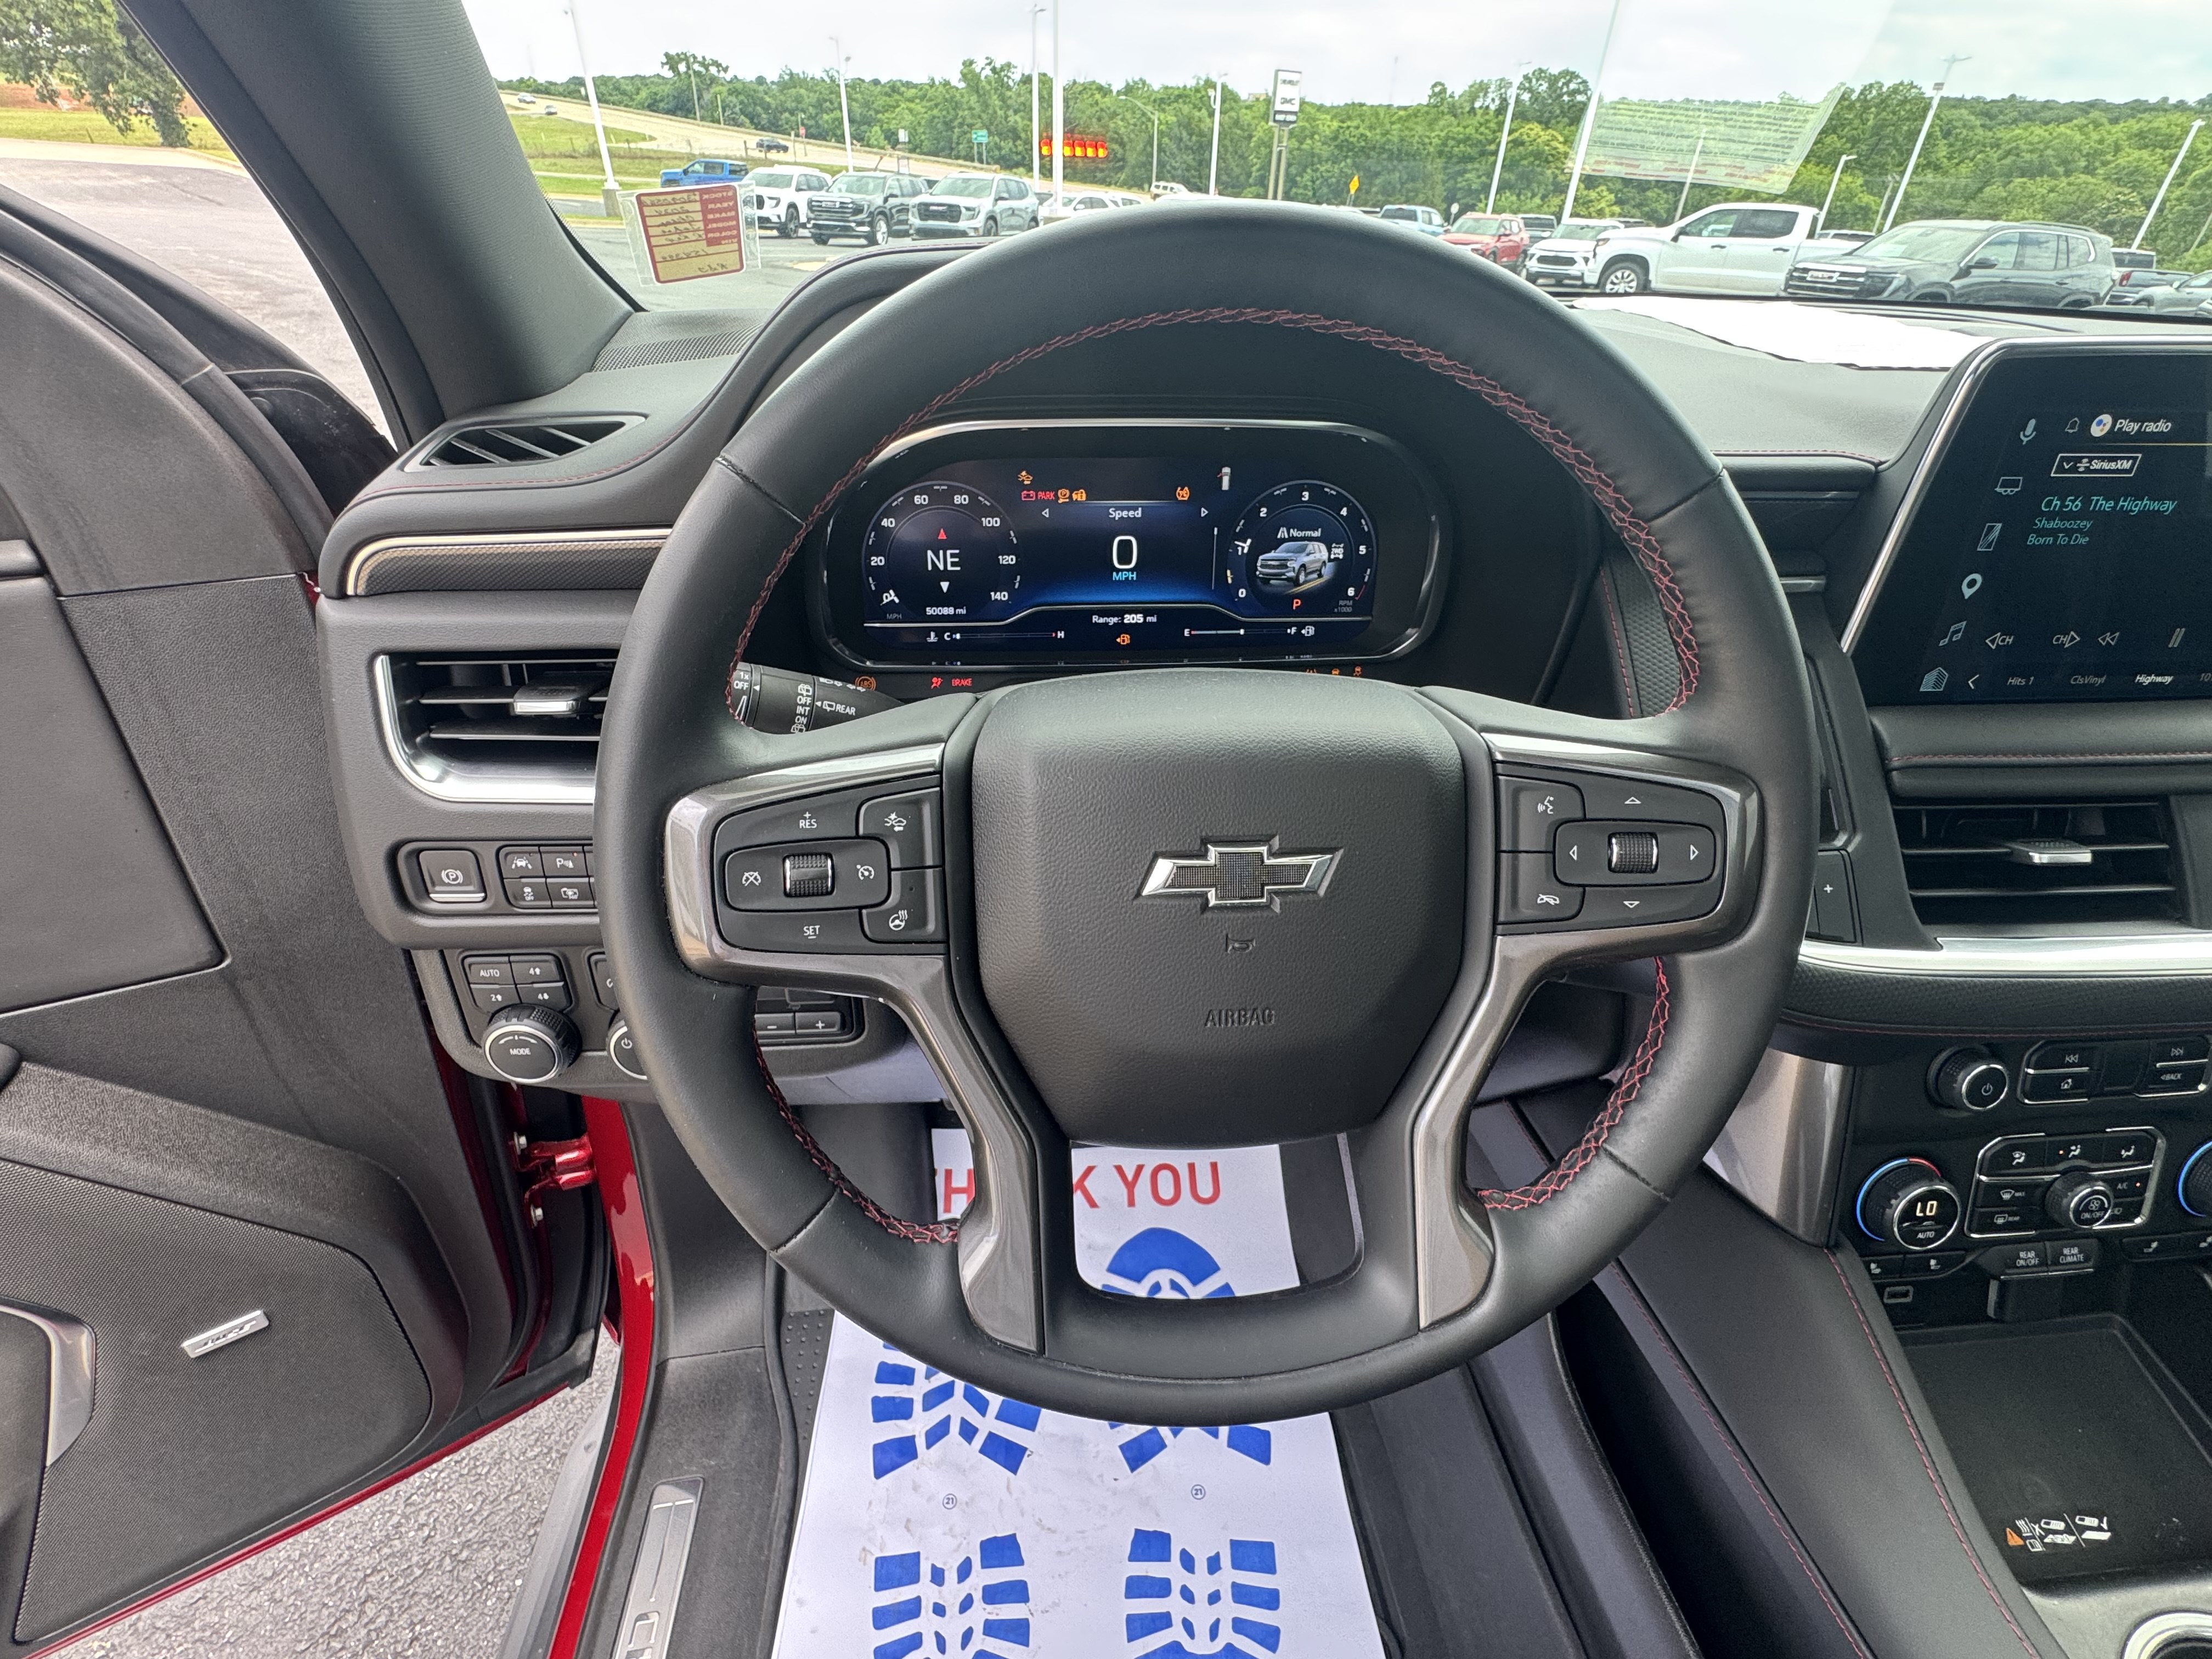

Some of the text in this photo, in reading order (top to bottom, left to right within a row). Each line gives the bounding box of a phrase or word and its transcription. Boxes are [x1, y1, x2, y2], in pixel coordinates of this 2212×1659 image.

[2114, 419, 2172, 435] Play radio
[2090, 459, 2133, 470] SiriusXM
[914, 495, 929, 505] 60
[954, 495, 969, 505] 80
[1037, 490, 1055, 500] PARK
[1302, 492, 1309, 501] 3
[2041, 496, 2178, 516] Ch 56 The Highway
[1109, 507, 1142, 520] Speed
[1260, 508, 1267, 517] 2
[1340, 507, 1347, 517] 4
[881, 518, 896, 528] 40
[981, 517, 1001, 527] 100
[2033, 517, 2095, 531] Shaboozey
[1290, 528, 1322, 537] Normal
[2027, 534, 2090, 545] Born To Die
[1112, 535, 1138, 569] 0
[1359, 545, 1367, 555] 5
[870, 556, 885, 566] 20
[927, 550, 961, 571] NE
[998, 555, 1016, 565] 120
[1113, 572, 1137, 581] MPH
[990, 592, 1008, 601] 140
[1238, 588, 1246, 598] 0
[1347, 587, 1355, 597] 6
[1293, 599, 1301, 610] P
[956, 606, 966, 615] mi
[1092, 614, 1157, 625] Range: 205 mi
[1057, 631, 1064, 639] H
[1184, 629, 1190, 637] E
[1291, 627, 1297, 635] F
[944, 632, 951, 641] C
[1999, 635, 2014, 645] CH
[2052, 635, 2067, 644] CH
[859, 680, 872, 688] ABS
[952, 678, 972, 686] BRAKE
[2007, 676, 2034, 685] Hits 1
[2135, 674, 2174, 686] Highway
[733, 681, 749, 690] OFF
[797, 697, 812, 705] OFF
[797, 705, 810, 715] INT
[836, 703, 856, 716] REAR
[795, 716, 808, 724] ON
[799, 819, 817, 830] RES
[804, 926, 820, 936] SET
[480, 969, 500, 978] AUTO
[1205, 1009, 1275, 1027] AIRBAG
[2166, 1073, 2182, 1081] BACK
[1113, 1161, 1221, 1208] YOU
[1916, 1200, 1937, 1216] LO
[2080, 1211, 2105, 1219] ON/OFF
[1916, 1231, 1935, 1239] AUTO
[2019, 1250, 2035, 1259] REAR
[2063, 1246, 2079, 1255] REAR
[2016, 1258, 2040, 1267] ON/OFF
[2059, 1254, 2084, 1263] CLIMATE
